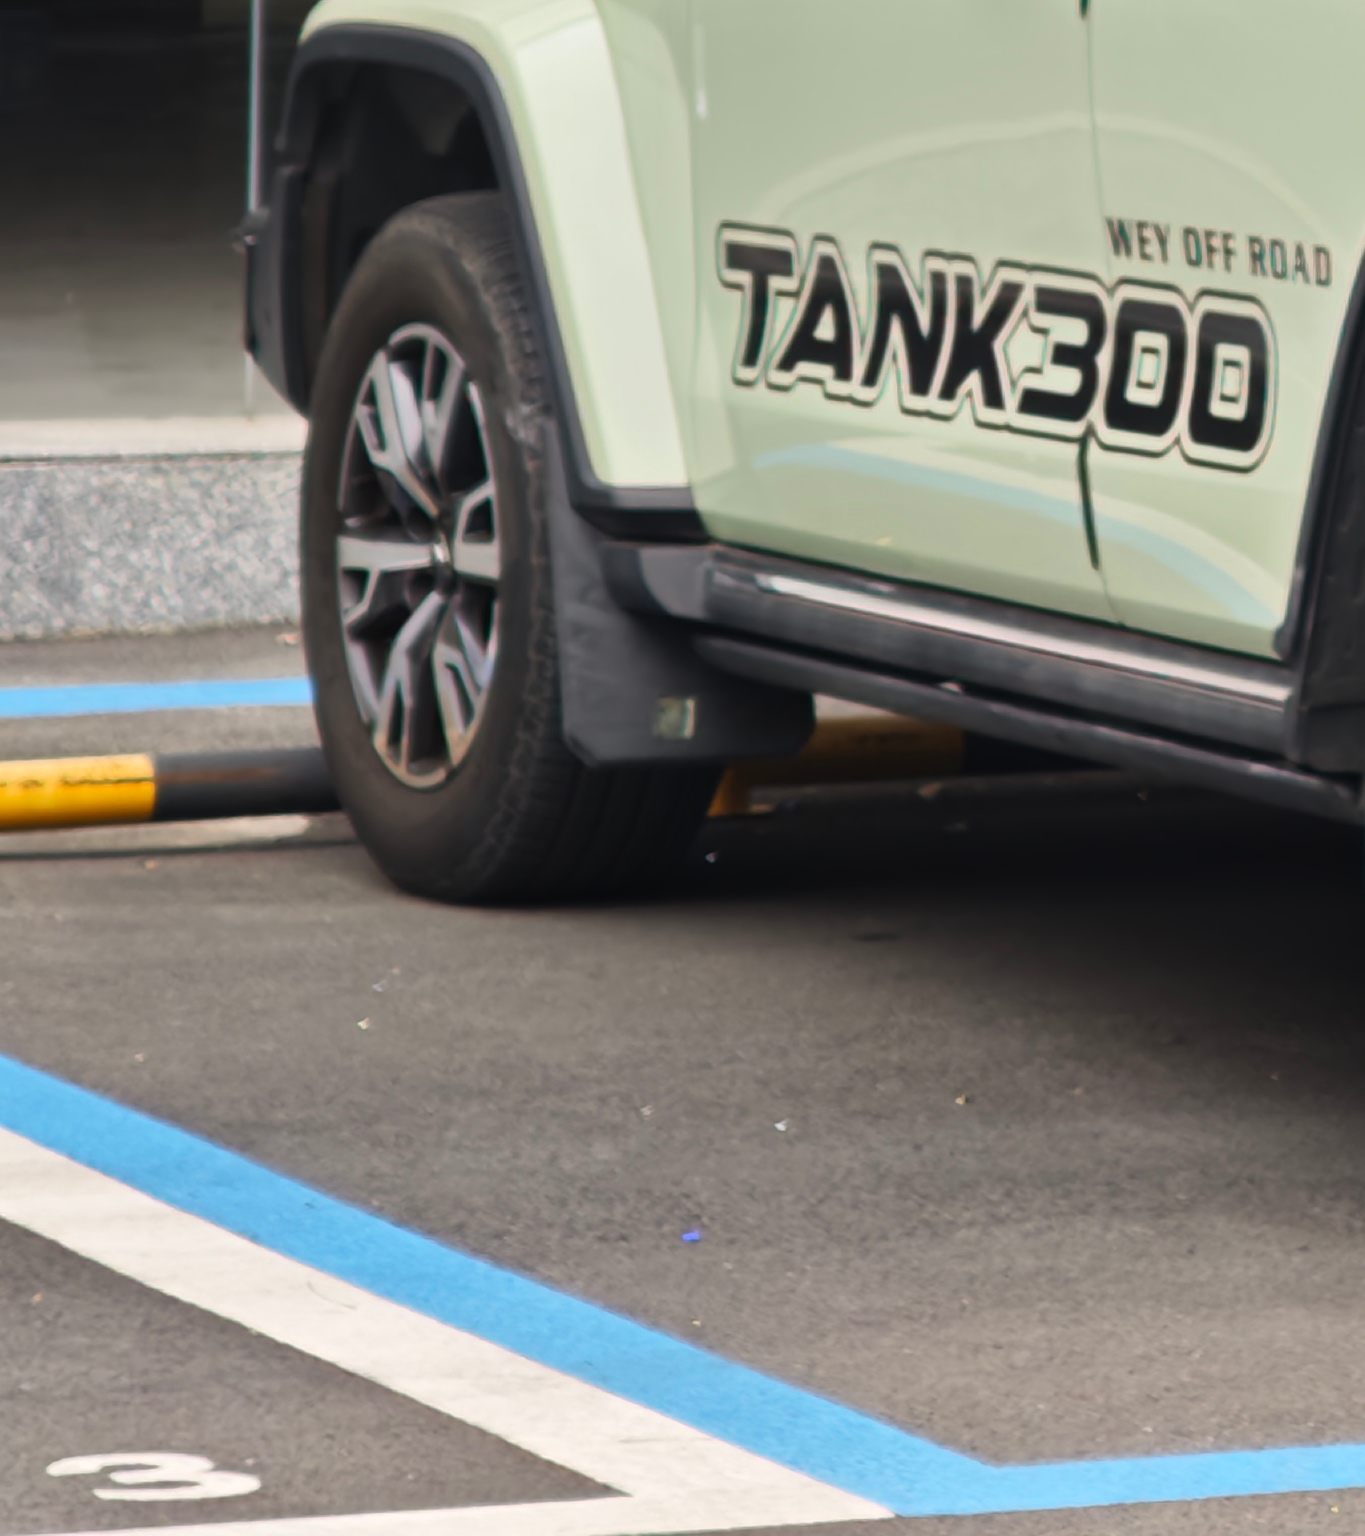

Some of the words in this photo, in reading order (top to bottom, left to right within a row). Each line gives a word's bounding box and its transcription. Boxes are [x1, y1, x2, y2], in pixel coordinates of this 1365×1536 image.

[1105, 216, 1171, 265] WEY
[1182, 224, 1238, 274] OFF
[1248, 234, 1334, 289] ROAD
[716, 219, 1279, 474] TANK300
[45, 1452, 262, 1502] 3
